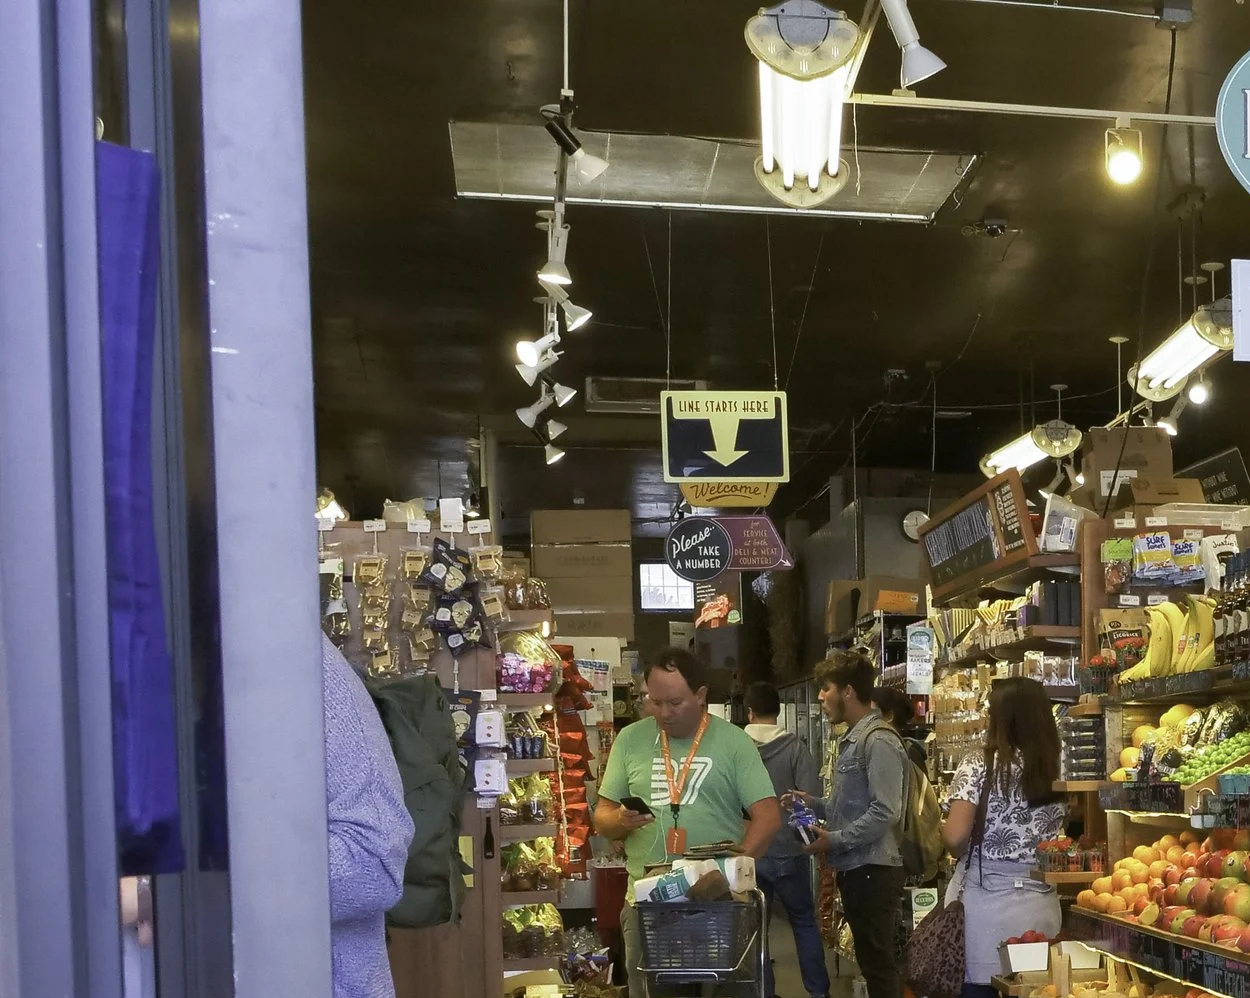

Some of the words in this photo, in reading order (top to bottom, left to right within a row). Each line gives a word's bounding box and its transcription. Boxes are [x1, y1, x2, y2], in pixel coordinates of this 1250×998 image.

[678, 400, 701, 413] LINE
[705, 400, 738, 413] STARTS
[742, 400, 769, 413] HERE
[743, 529, 768, 538] SERVICE
[1146, 535, 1165, 546] SURF
[698, 546, 720, 556] TAKE
[760, 547, 777, 555] MEAT
[1174, 542, 1193, 552] SURF
[676, 560, 682, 570] A
[685, 559, 721, 569] NUMBER
